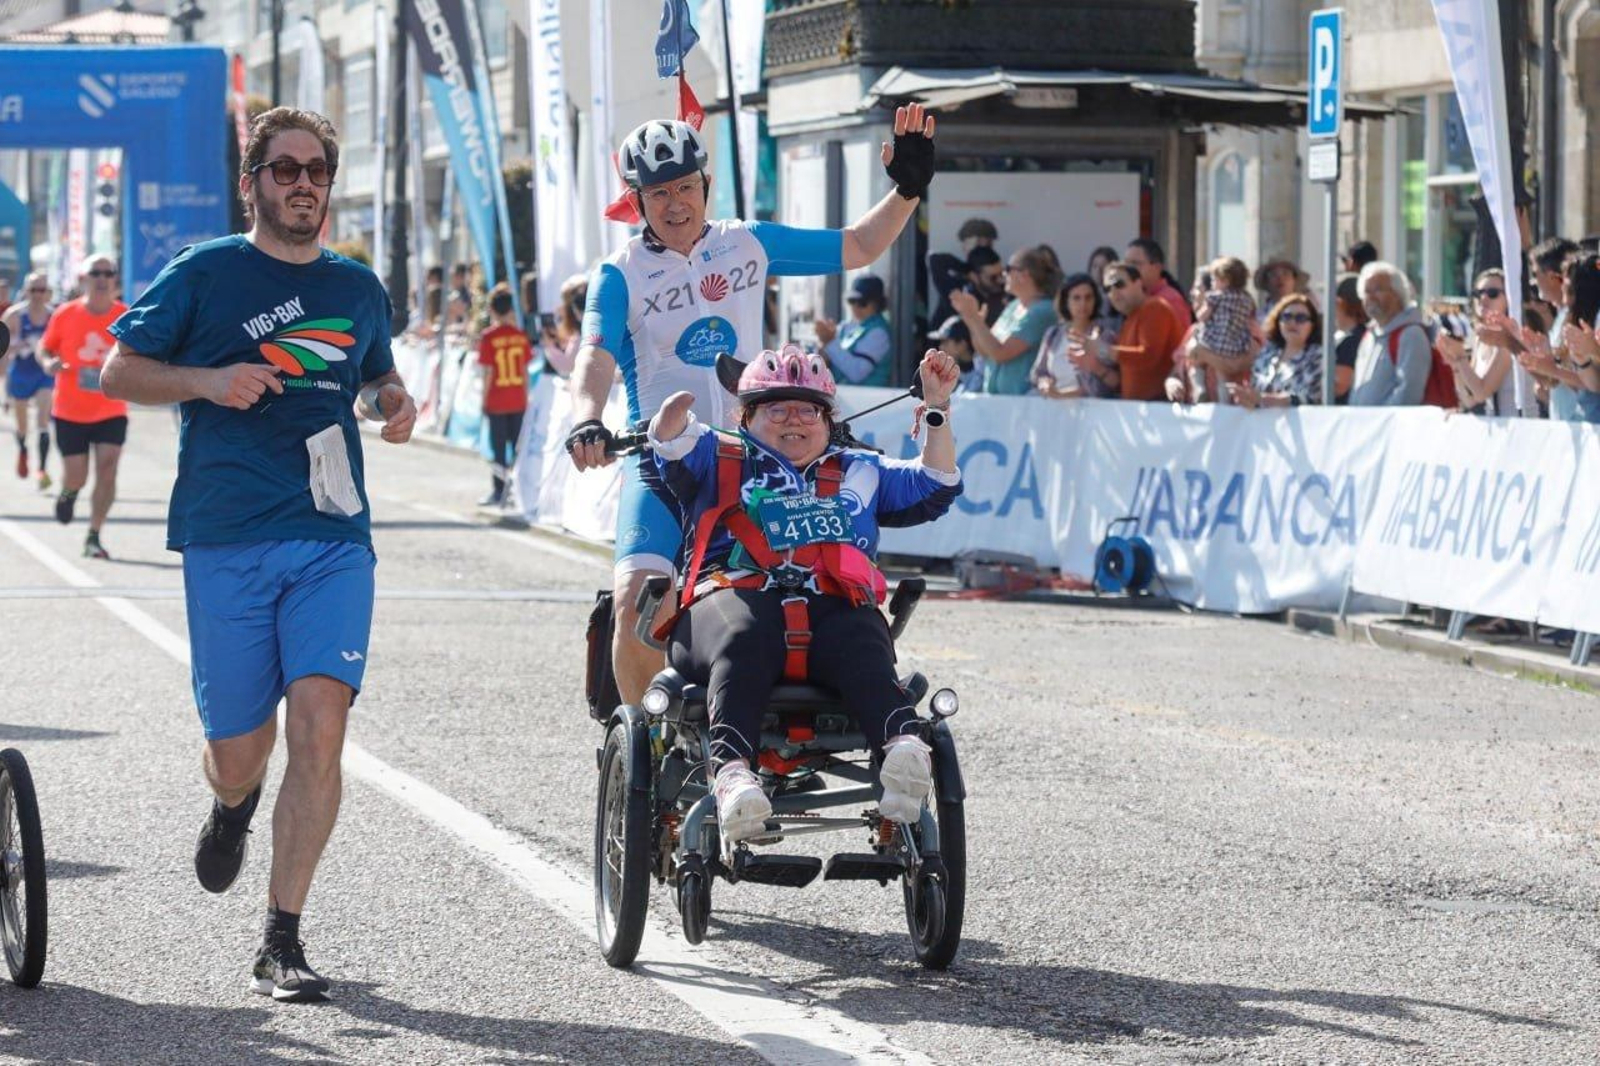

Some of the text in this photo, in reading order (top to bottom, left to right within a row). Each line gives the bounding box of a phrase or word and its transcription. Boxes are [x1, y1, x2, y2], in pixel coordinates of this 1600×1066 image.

[1313, 27, 1335, 121] P
[729, 260, 759, 293] 22
[784, 515, 843, 540] 4133
